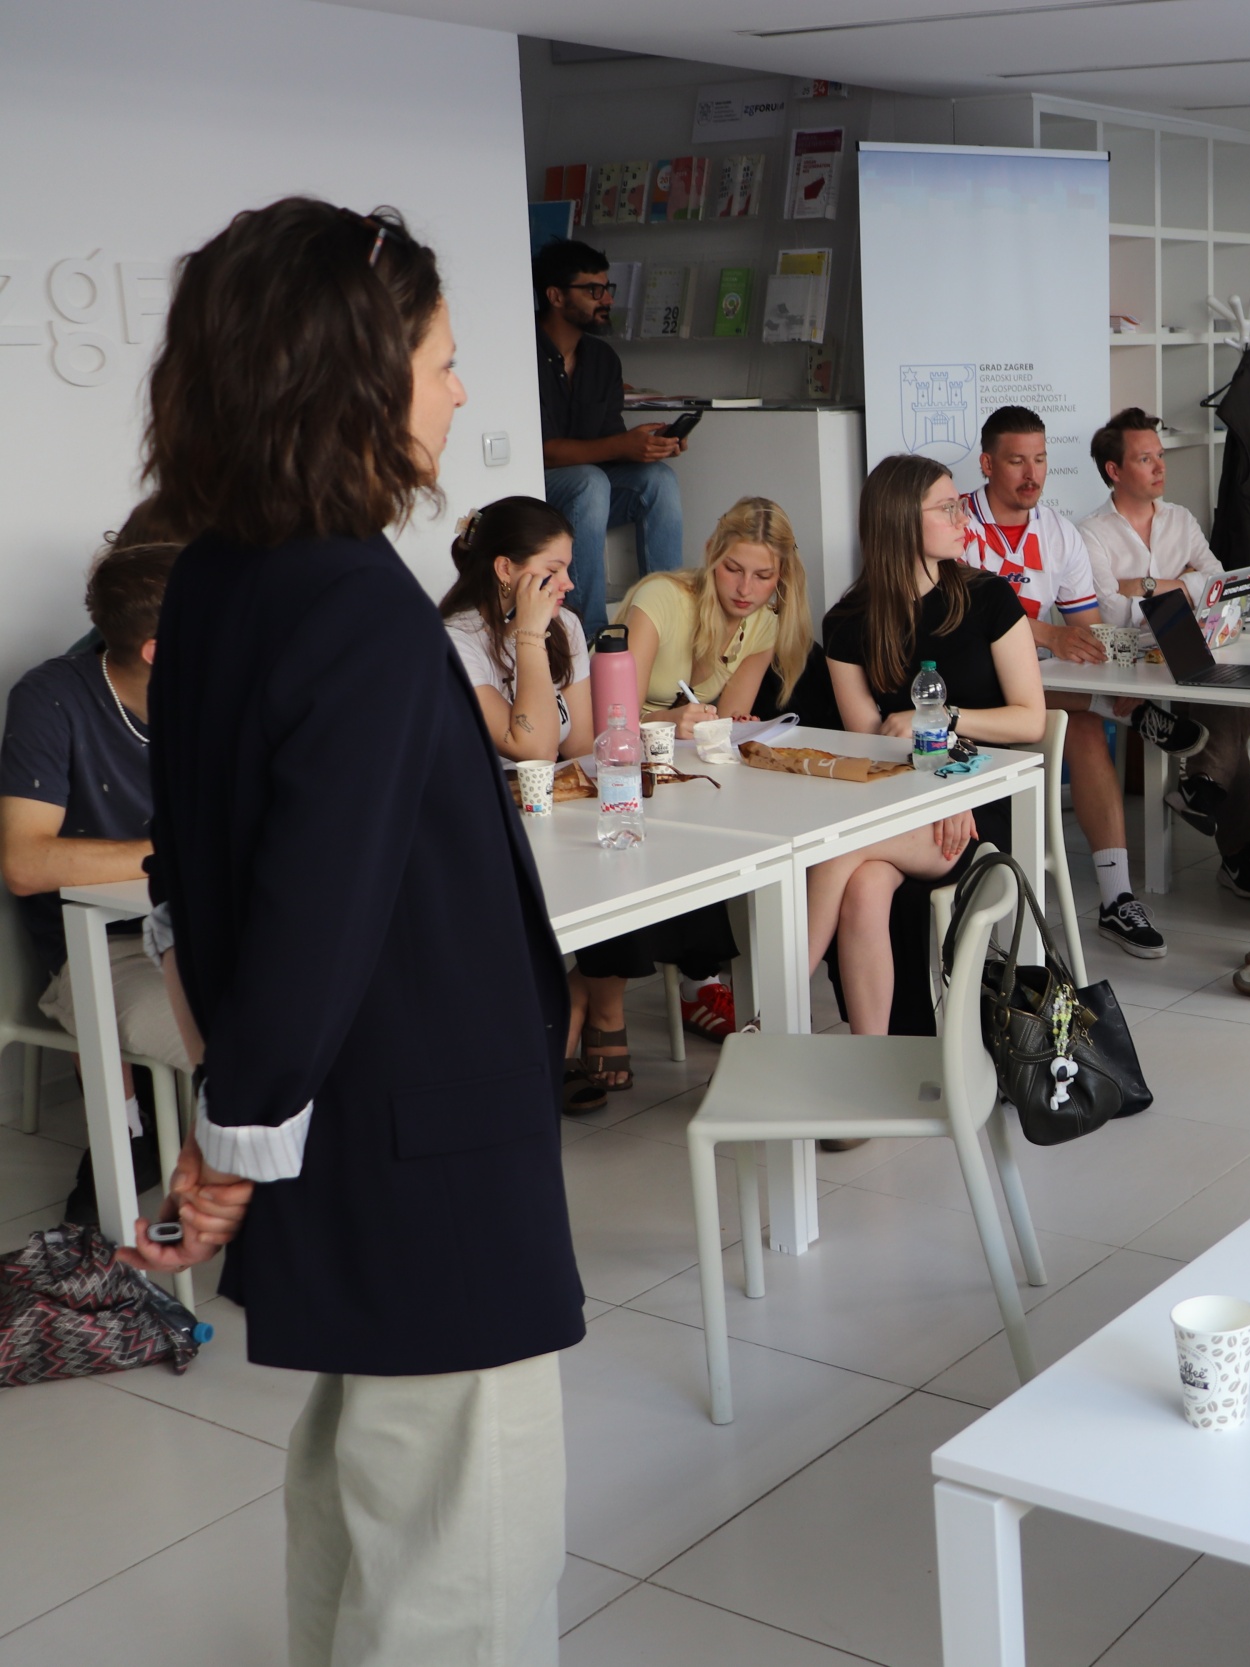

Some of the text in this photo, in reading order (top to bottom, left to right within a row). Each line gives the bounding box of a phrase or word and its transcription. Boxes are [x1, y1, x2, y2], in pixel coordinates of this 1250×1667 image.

[663, 306, 679, 319] 20
[662, 321, 678, 334] 22
[979, 363, 1034, 372] GRAD ZAGREB
[979, 374, 1033, 382] GRADSKI URED
[980, 394, 1018, 404] EKOLOŠKU
[1020, 393, 1062, 403] ODRŽIVOST
[1033, 404, 1076, 413] PLANIRANJE
[1046, 436, 1080, 445] CONOMY,
[1047, 467, 1078, 475] ANNING
[1180, 1361, 1208, 1381] offee
